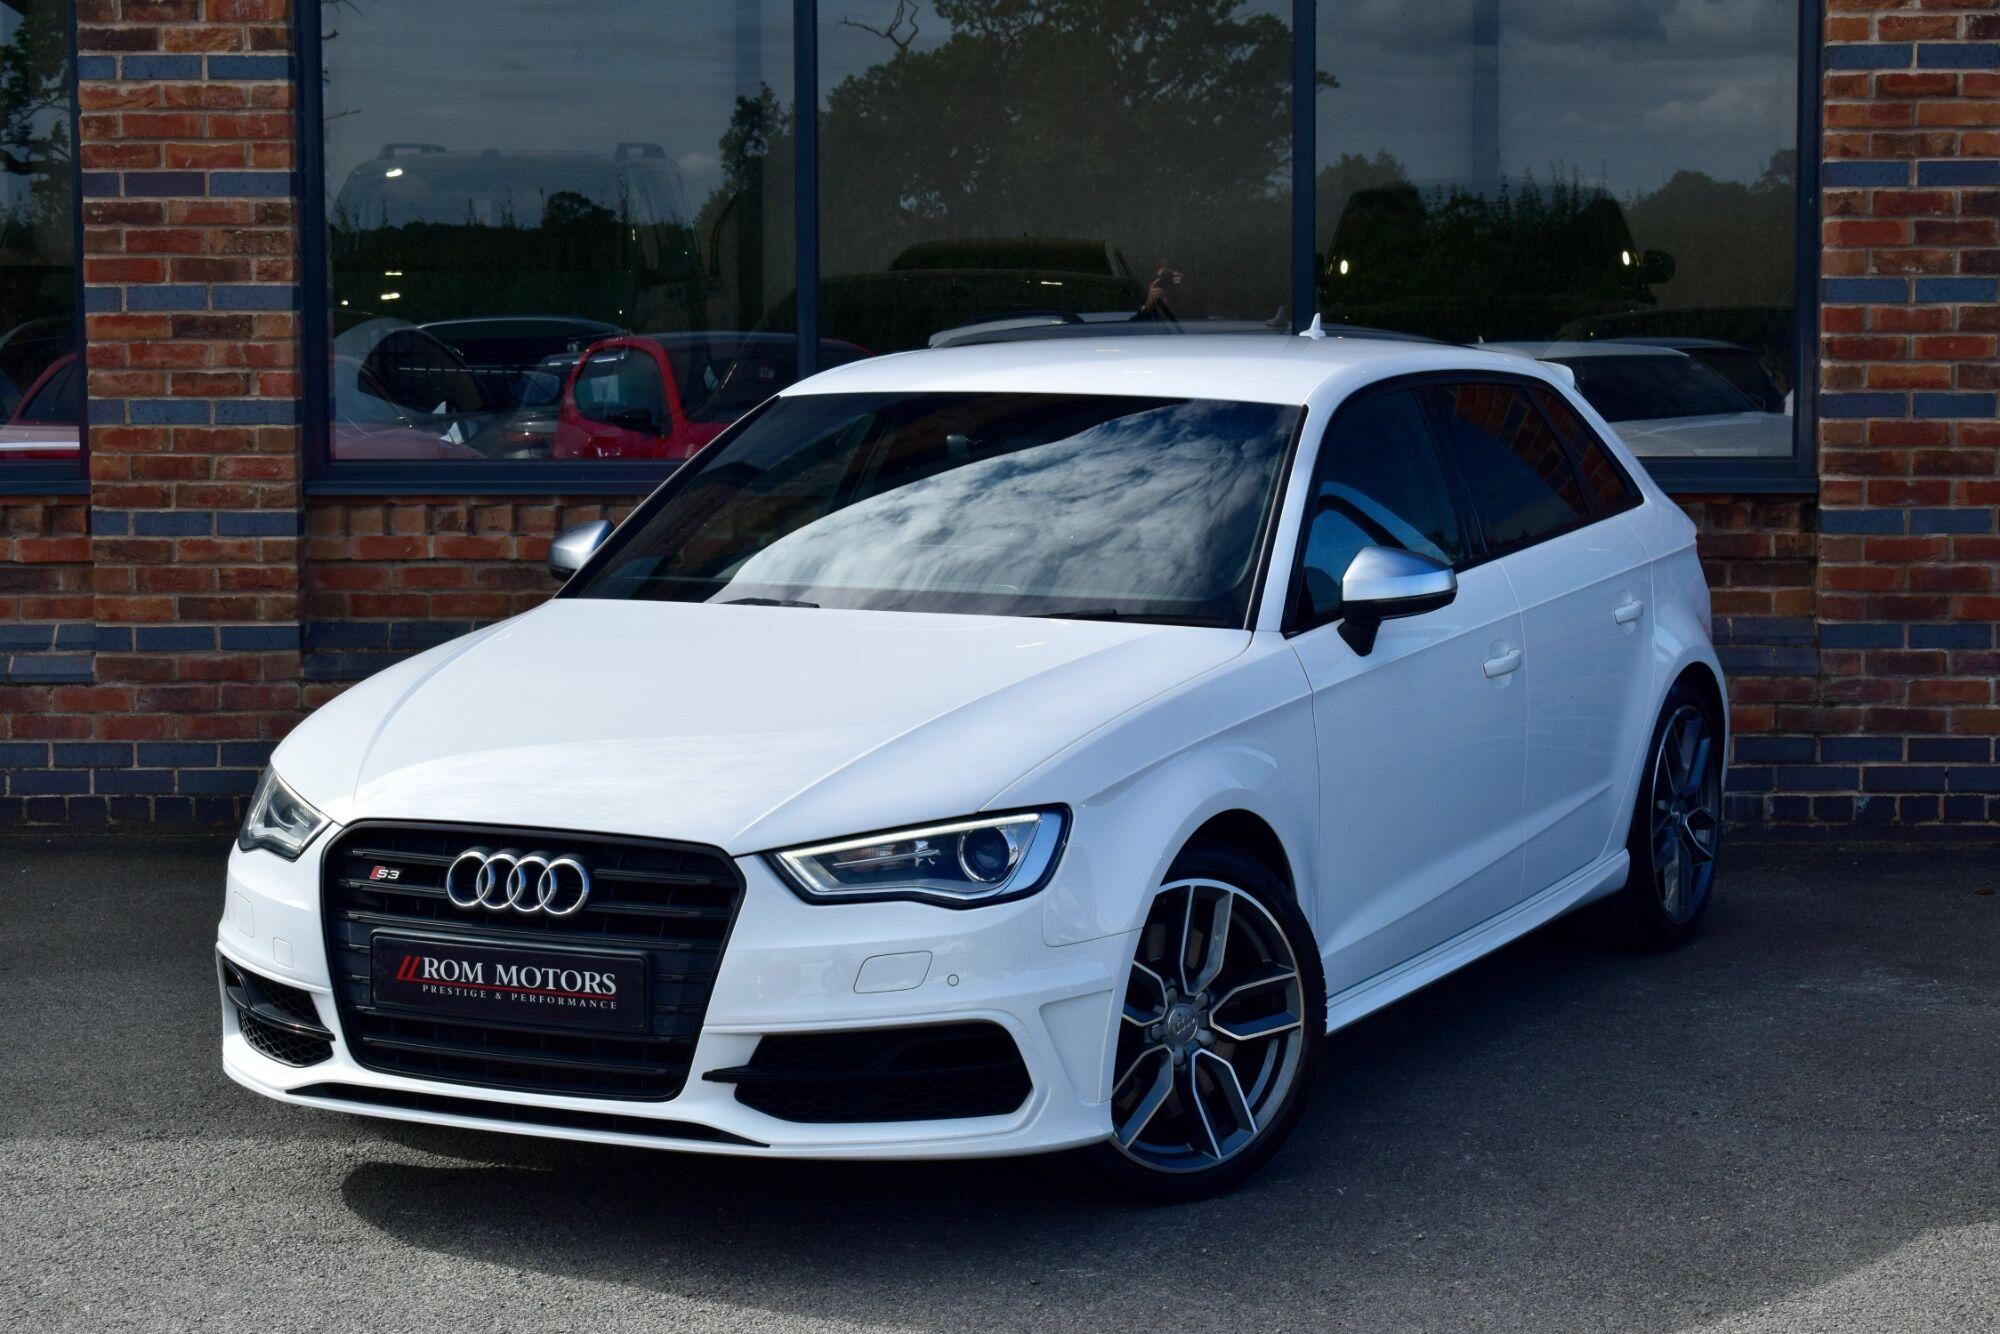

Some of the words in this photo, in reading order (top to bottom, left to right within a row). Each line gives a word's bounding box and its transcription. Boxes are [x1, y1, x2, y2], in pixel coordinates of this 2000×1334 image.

[376, 869, 400, 880] S3
[422, 956, 485, 985] ROM
[494, 963, 617, 995] MOTORS
[422, 984, 487, 999] PRESTIGE
[495, 992, 502, 1000] &
[511, 993, 617, 1010] PERFORMANCE
